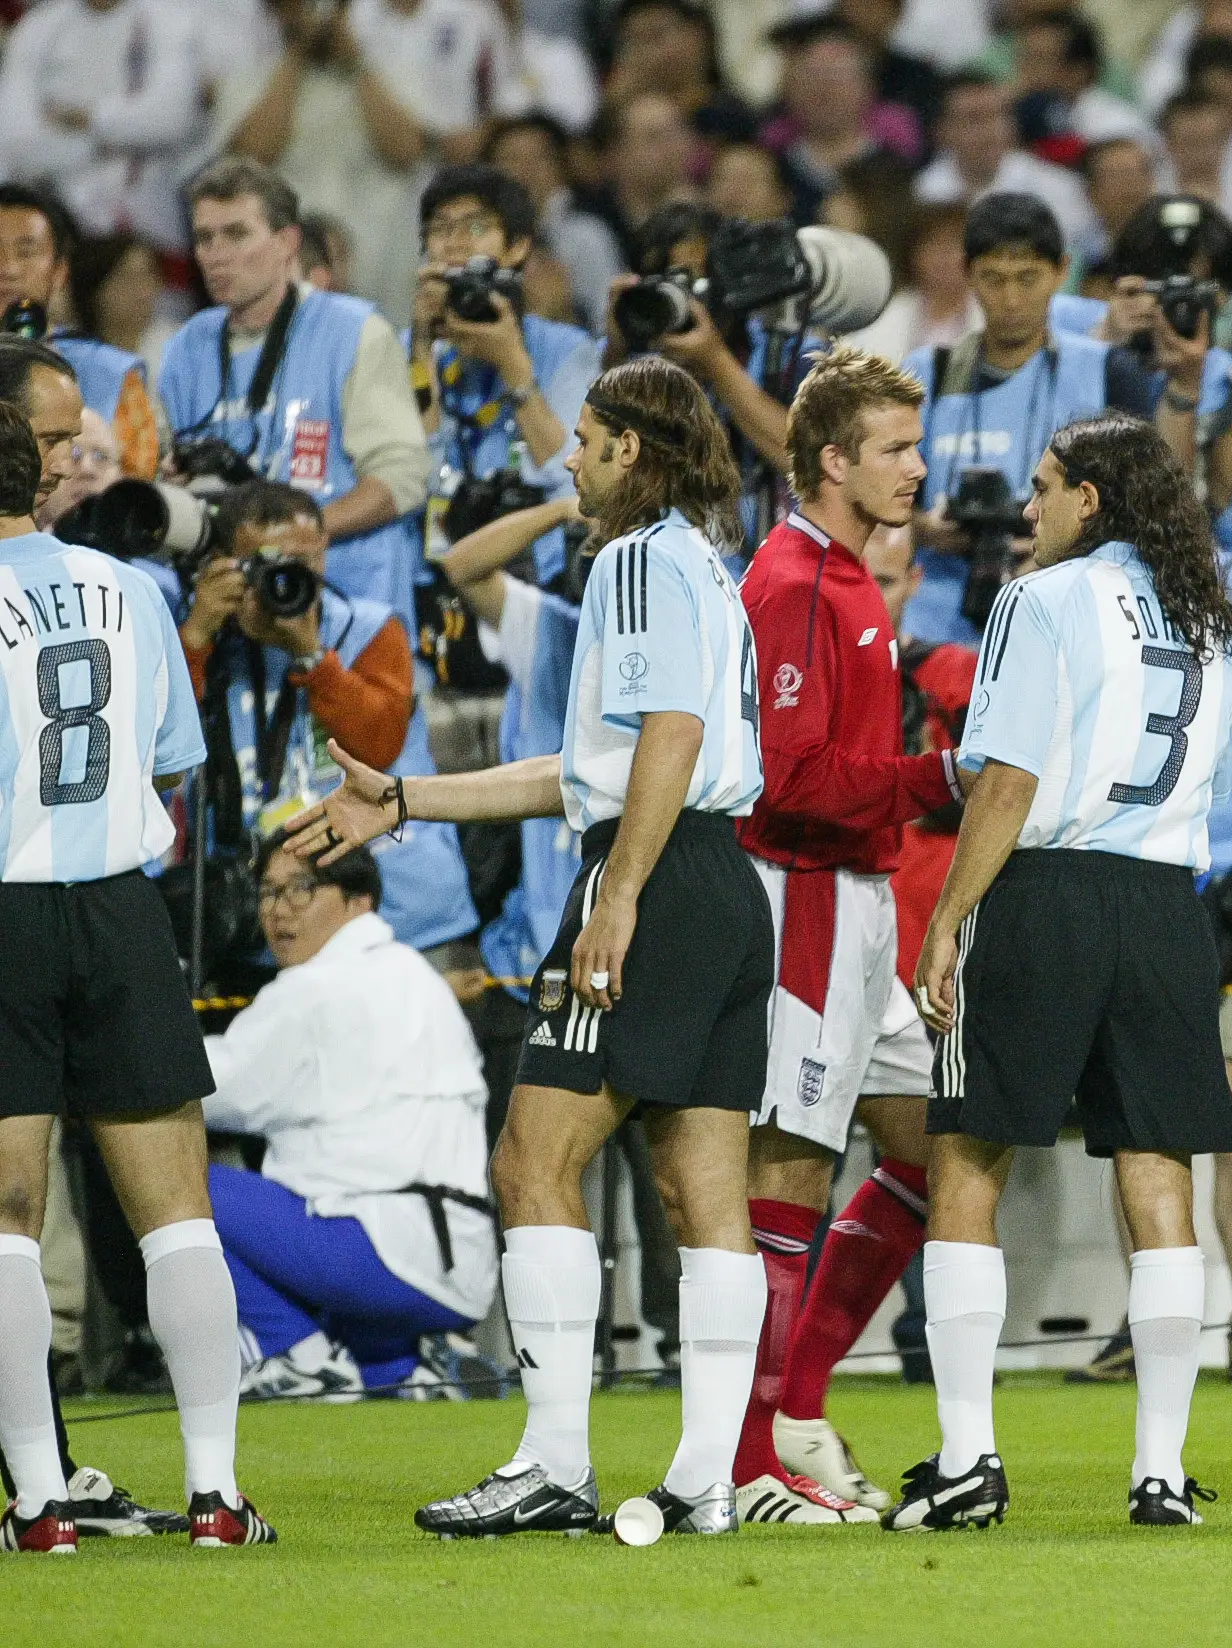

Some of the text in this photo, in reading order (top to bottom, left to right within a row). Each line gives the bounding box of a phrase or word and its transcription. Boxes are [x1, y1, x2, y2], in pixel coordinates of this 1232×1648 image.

[37, 638, 111, 806] 8
[1106, 644, 1203, 806] 3
[528, 1035, 557, 1047] adidas
